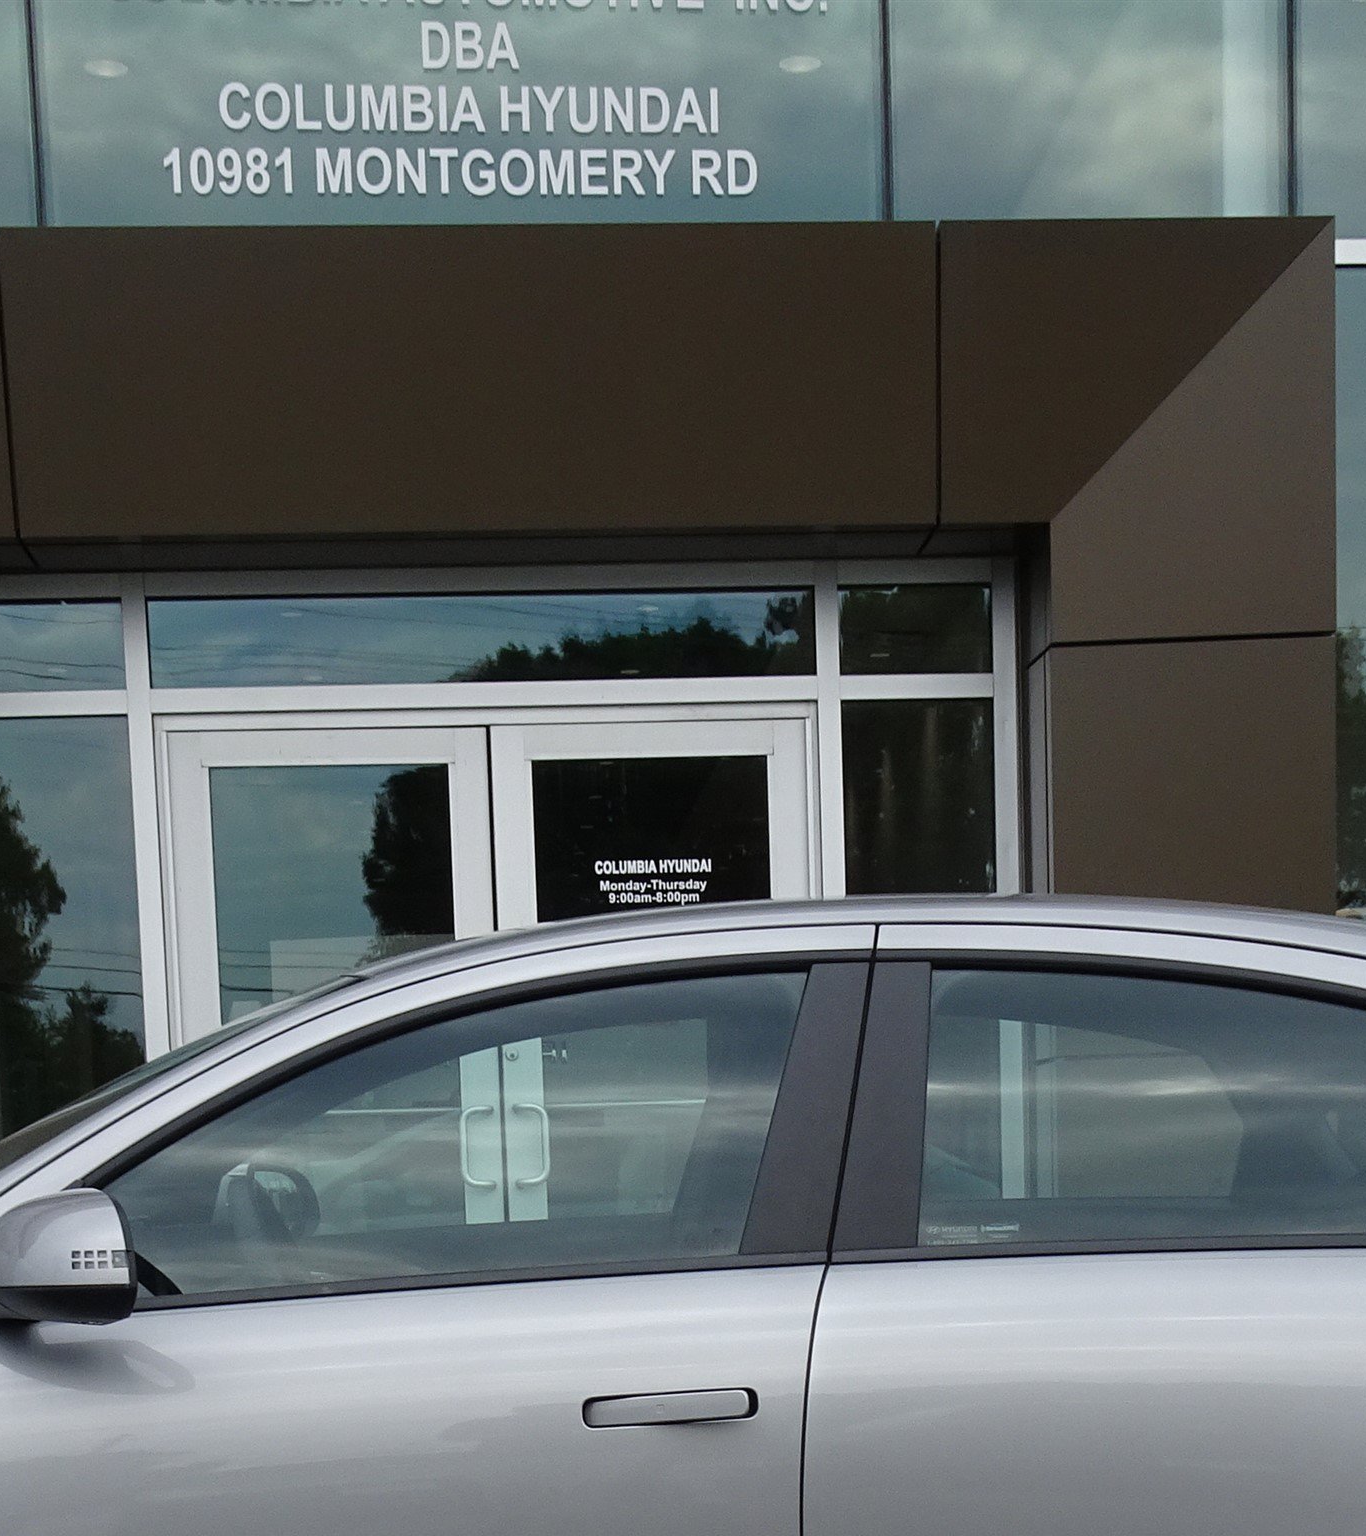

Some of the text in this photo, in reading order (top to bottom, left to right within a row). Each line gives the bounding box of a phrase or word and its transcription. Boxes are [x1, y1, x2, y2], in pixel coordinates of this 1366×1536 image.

[421, 21, 520, 70] DBA
[218, 83, 719, 134] COLUMBIA HYUNDAI
[163, 147, 759, 197] 10981 MONTGOMERY RD
[594, 858, 712, 875] COLUMBIA HYUNDAI
[599, 879, 708, 892] Monday-Thursday
[608, 891, 700, 906] 9:00am-8:00pm
